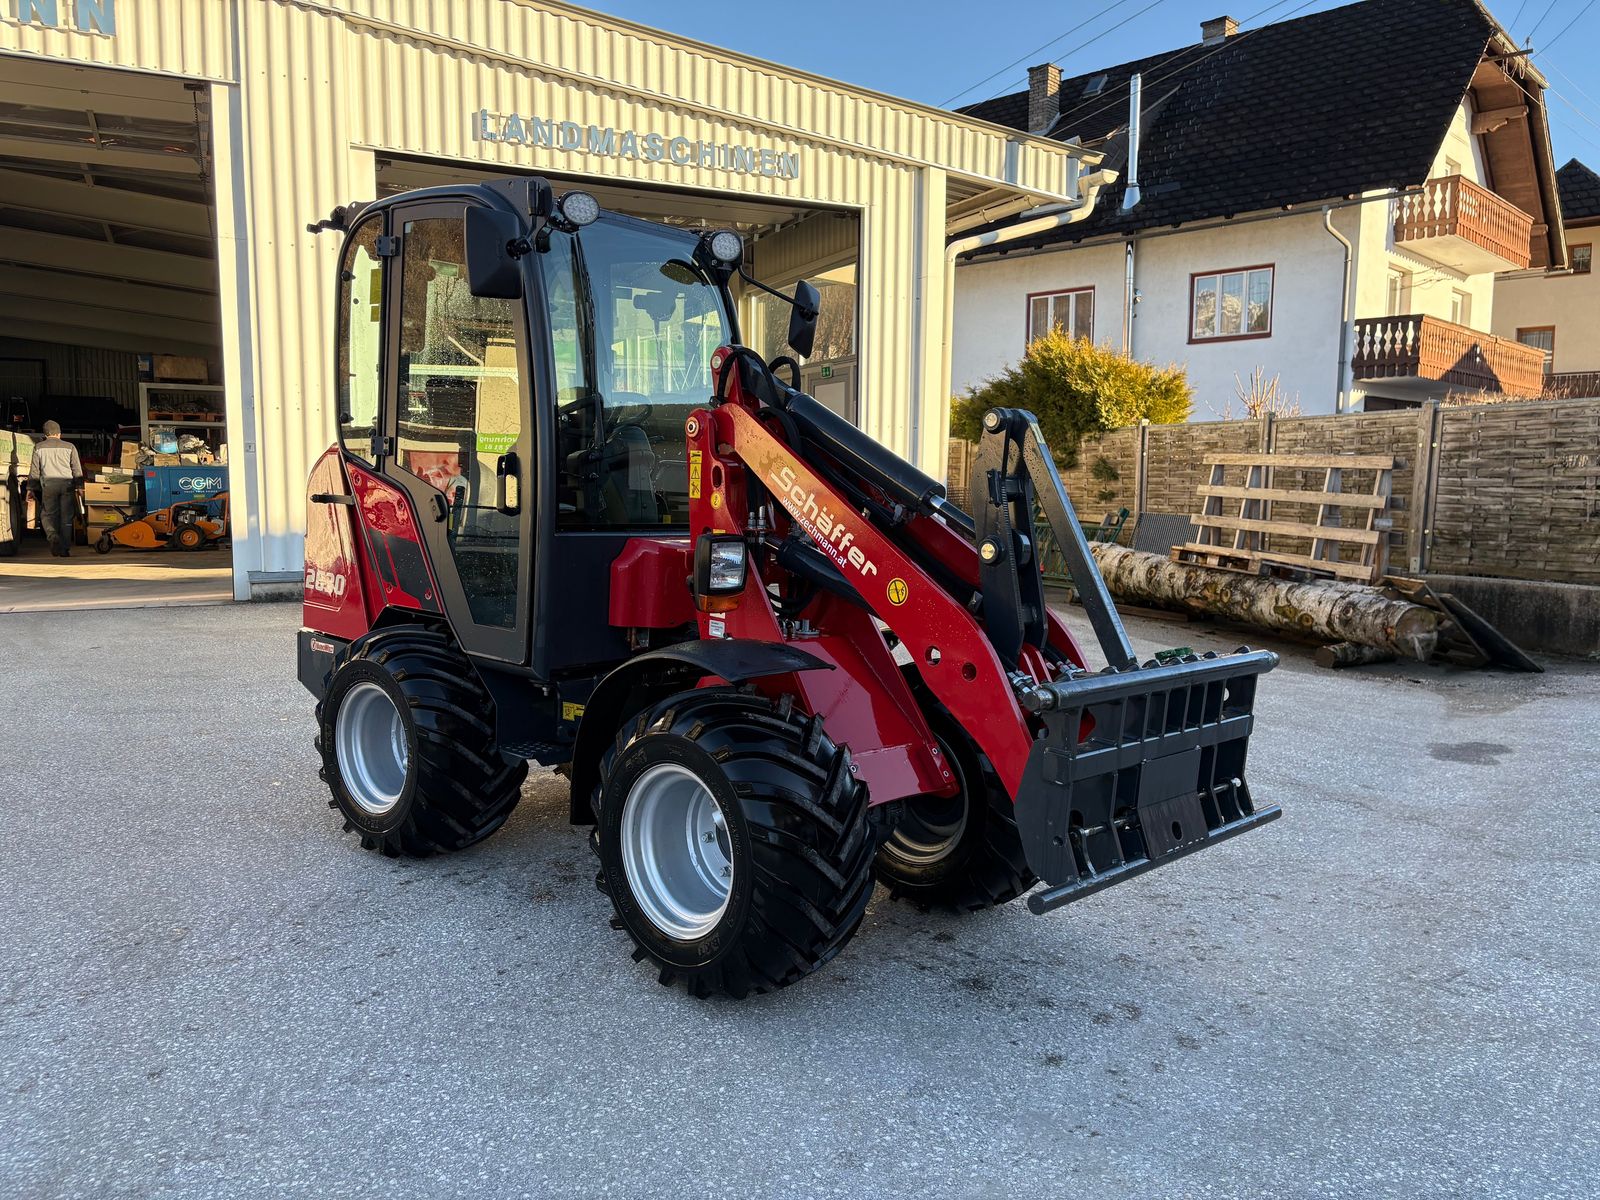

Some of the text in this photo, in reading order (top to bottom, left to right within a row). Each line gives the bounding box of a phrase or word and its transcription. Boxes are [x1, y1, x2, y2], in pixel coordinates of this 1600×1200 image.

[476, 108, 799, 179] LANDMASCHINEN
[178, 476, 222, 490] CGM
[770, 466, 878, 576] Schäffer
[782, 496, 848, 569] www.zechmann.at
